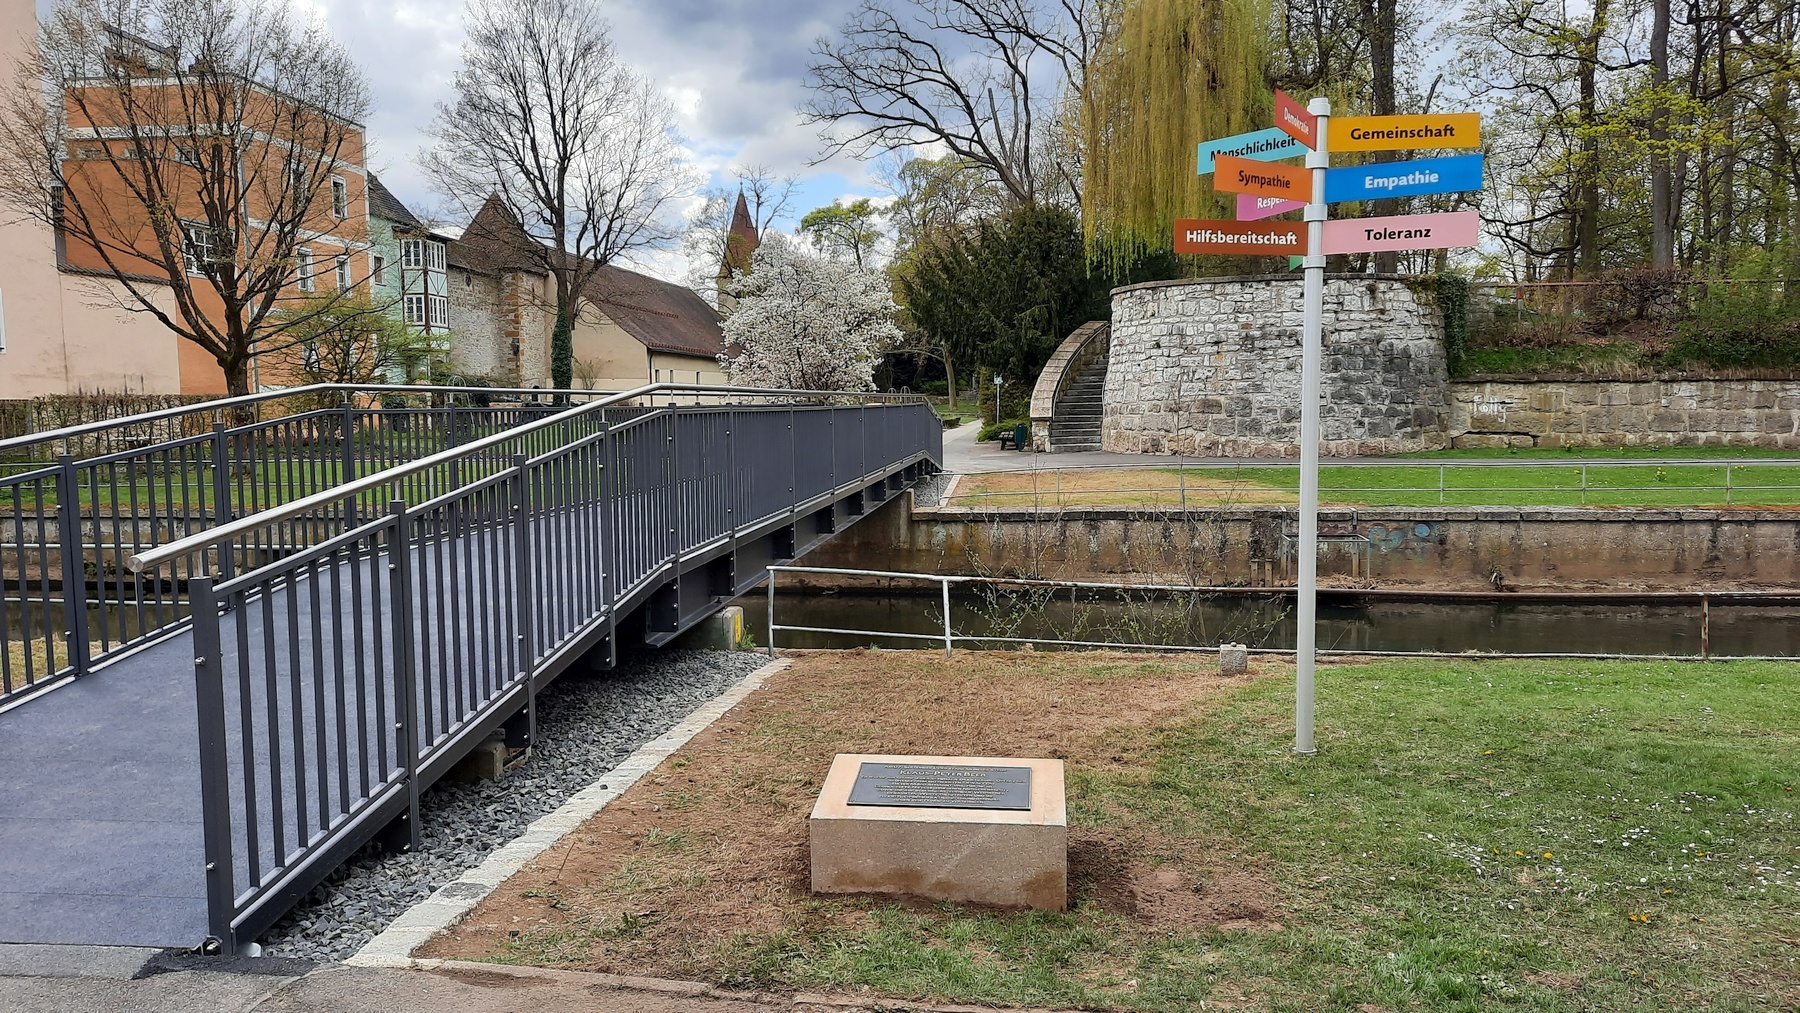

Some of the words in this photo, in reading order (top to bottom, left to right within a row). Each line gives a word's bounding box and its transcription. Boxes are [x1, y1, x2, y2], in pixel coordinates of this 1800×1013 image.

[1283, 106, 1310, 135] Demokratie
[1350, 124, 1455, 140] Gemeinschaft
[1238, 169, 1291, 189] Sympathie
[1364, 170, 1439, 190] Empathie
[1186, 229, 1298, 245] Hilfsbereitschaft
[1364, 227, 1431, 241] Toleranz
